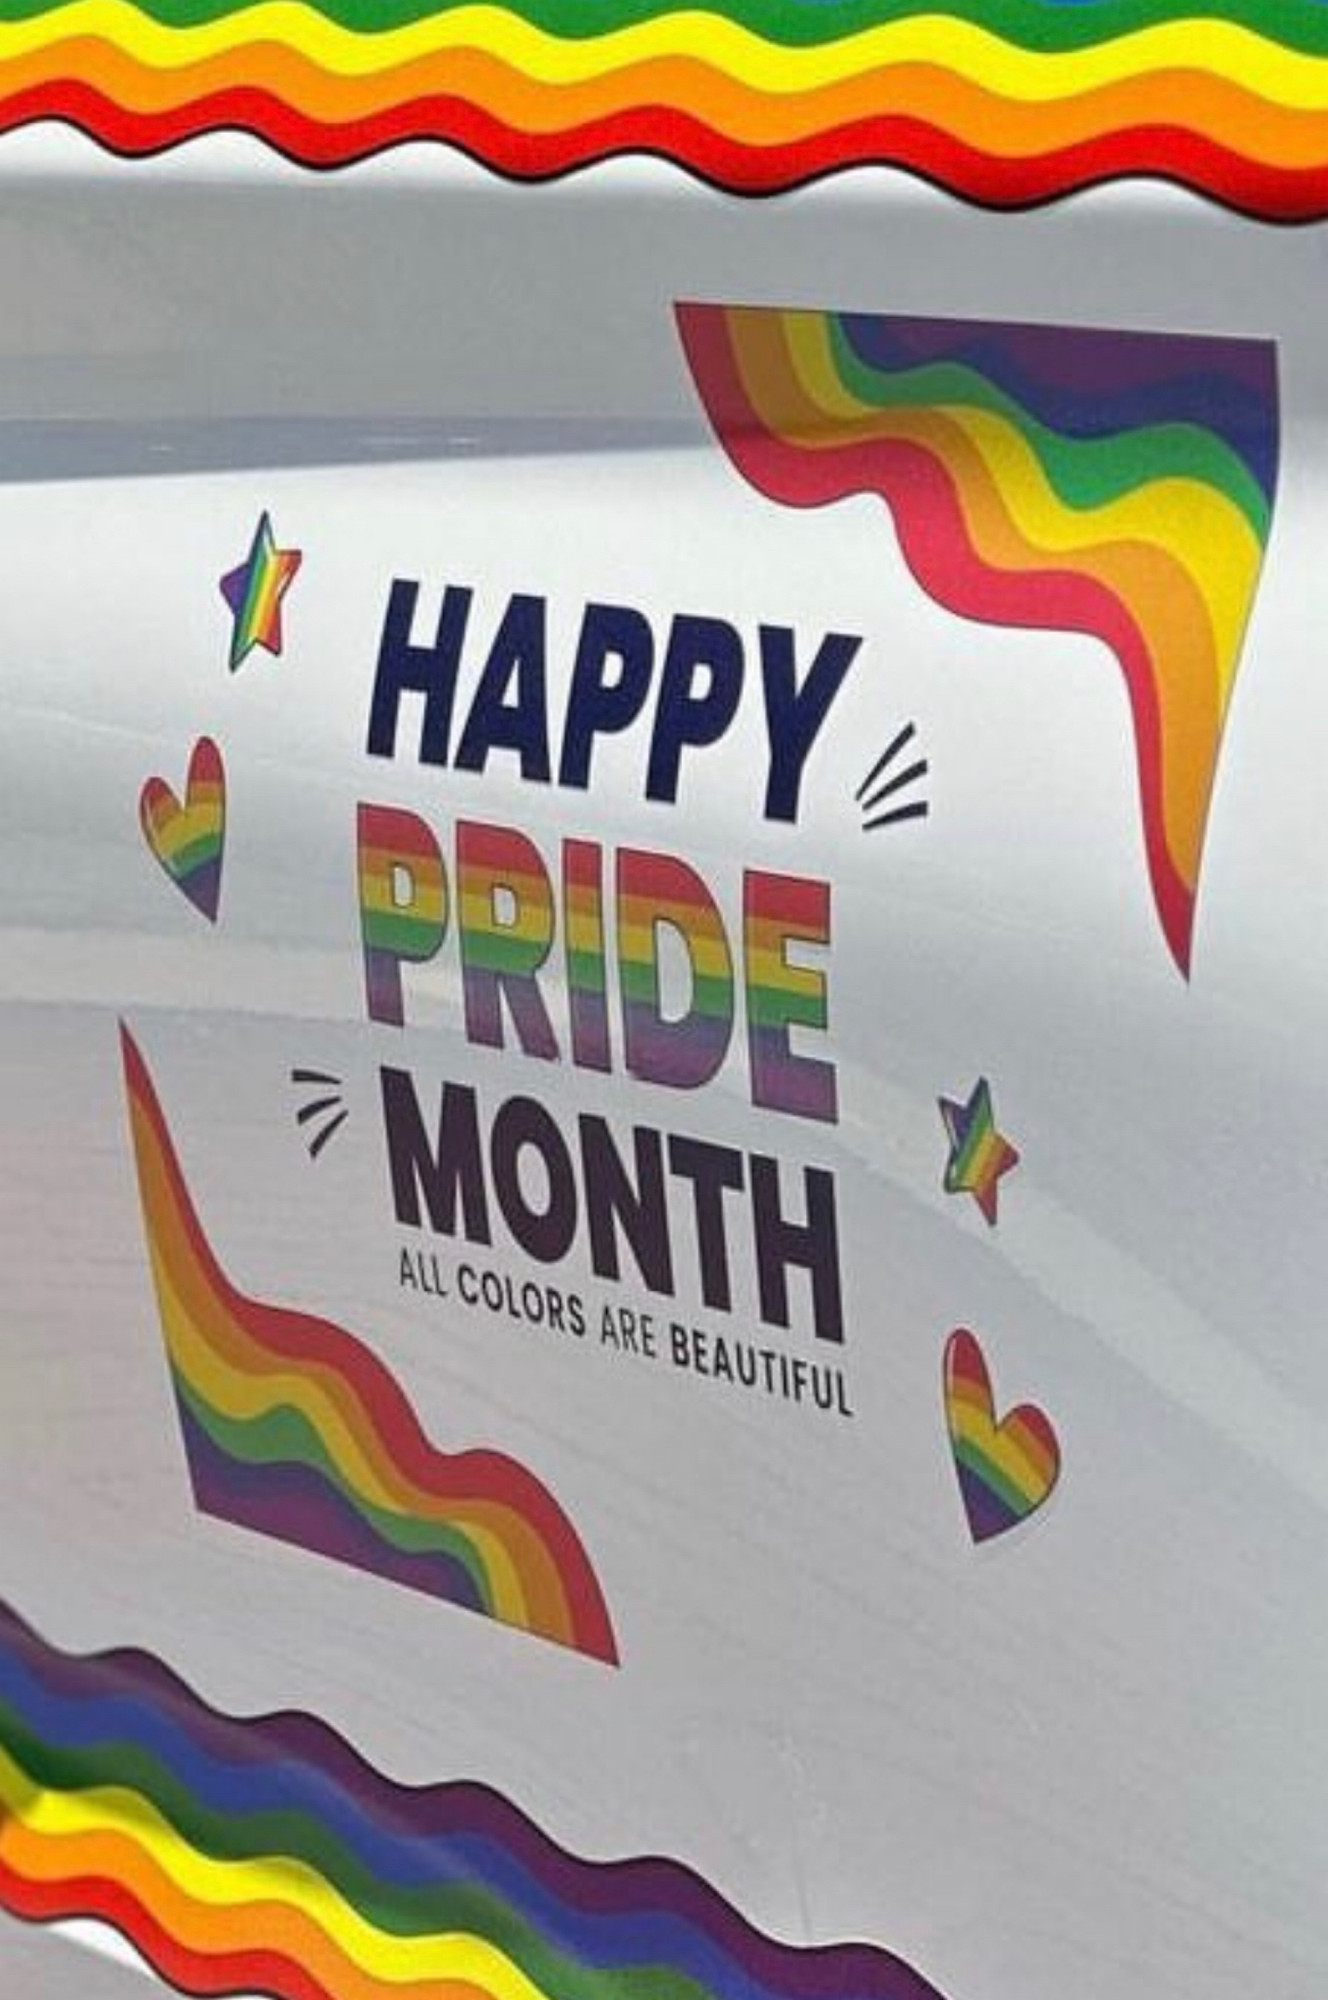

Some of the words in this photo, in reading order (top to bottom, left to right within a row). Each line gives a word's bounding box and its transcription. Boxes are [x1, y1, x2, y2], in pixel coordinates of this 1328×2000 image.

[366, 578, 864, 825] HAPPY
[356, 800, 839, 1125] PRIDE
[380, 1065, 845, 1345] MONTH
[400, 1247, 448, 1297] ALL
[457, 1263, 587, 1336] COLORS
[600, 1307, 657, 1358] ARE
[670, 1323, 854, 1417] BEAUTIFUL
